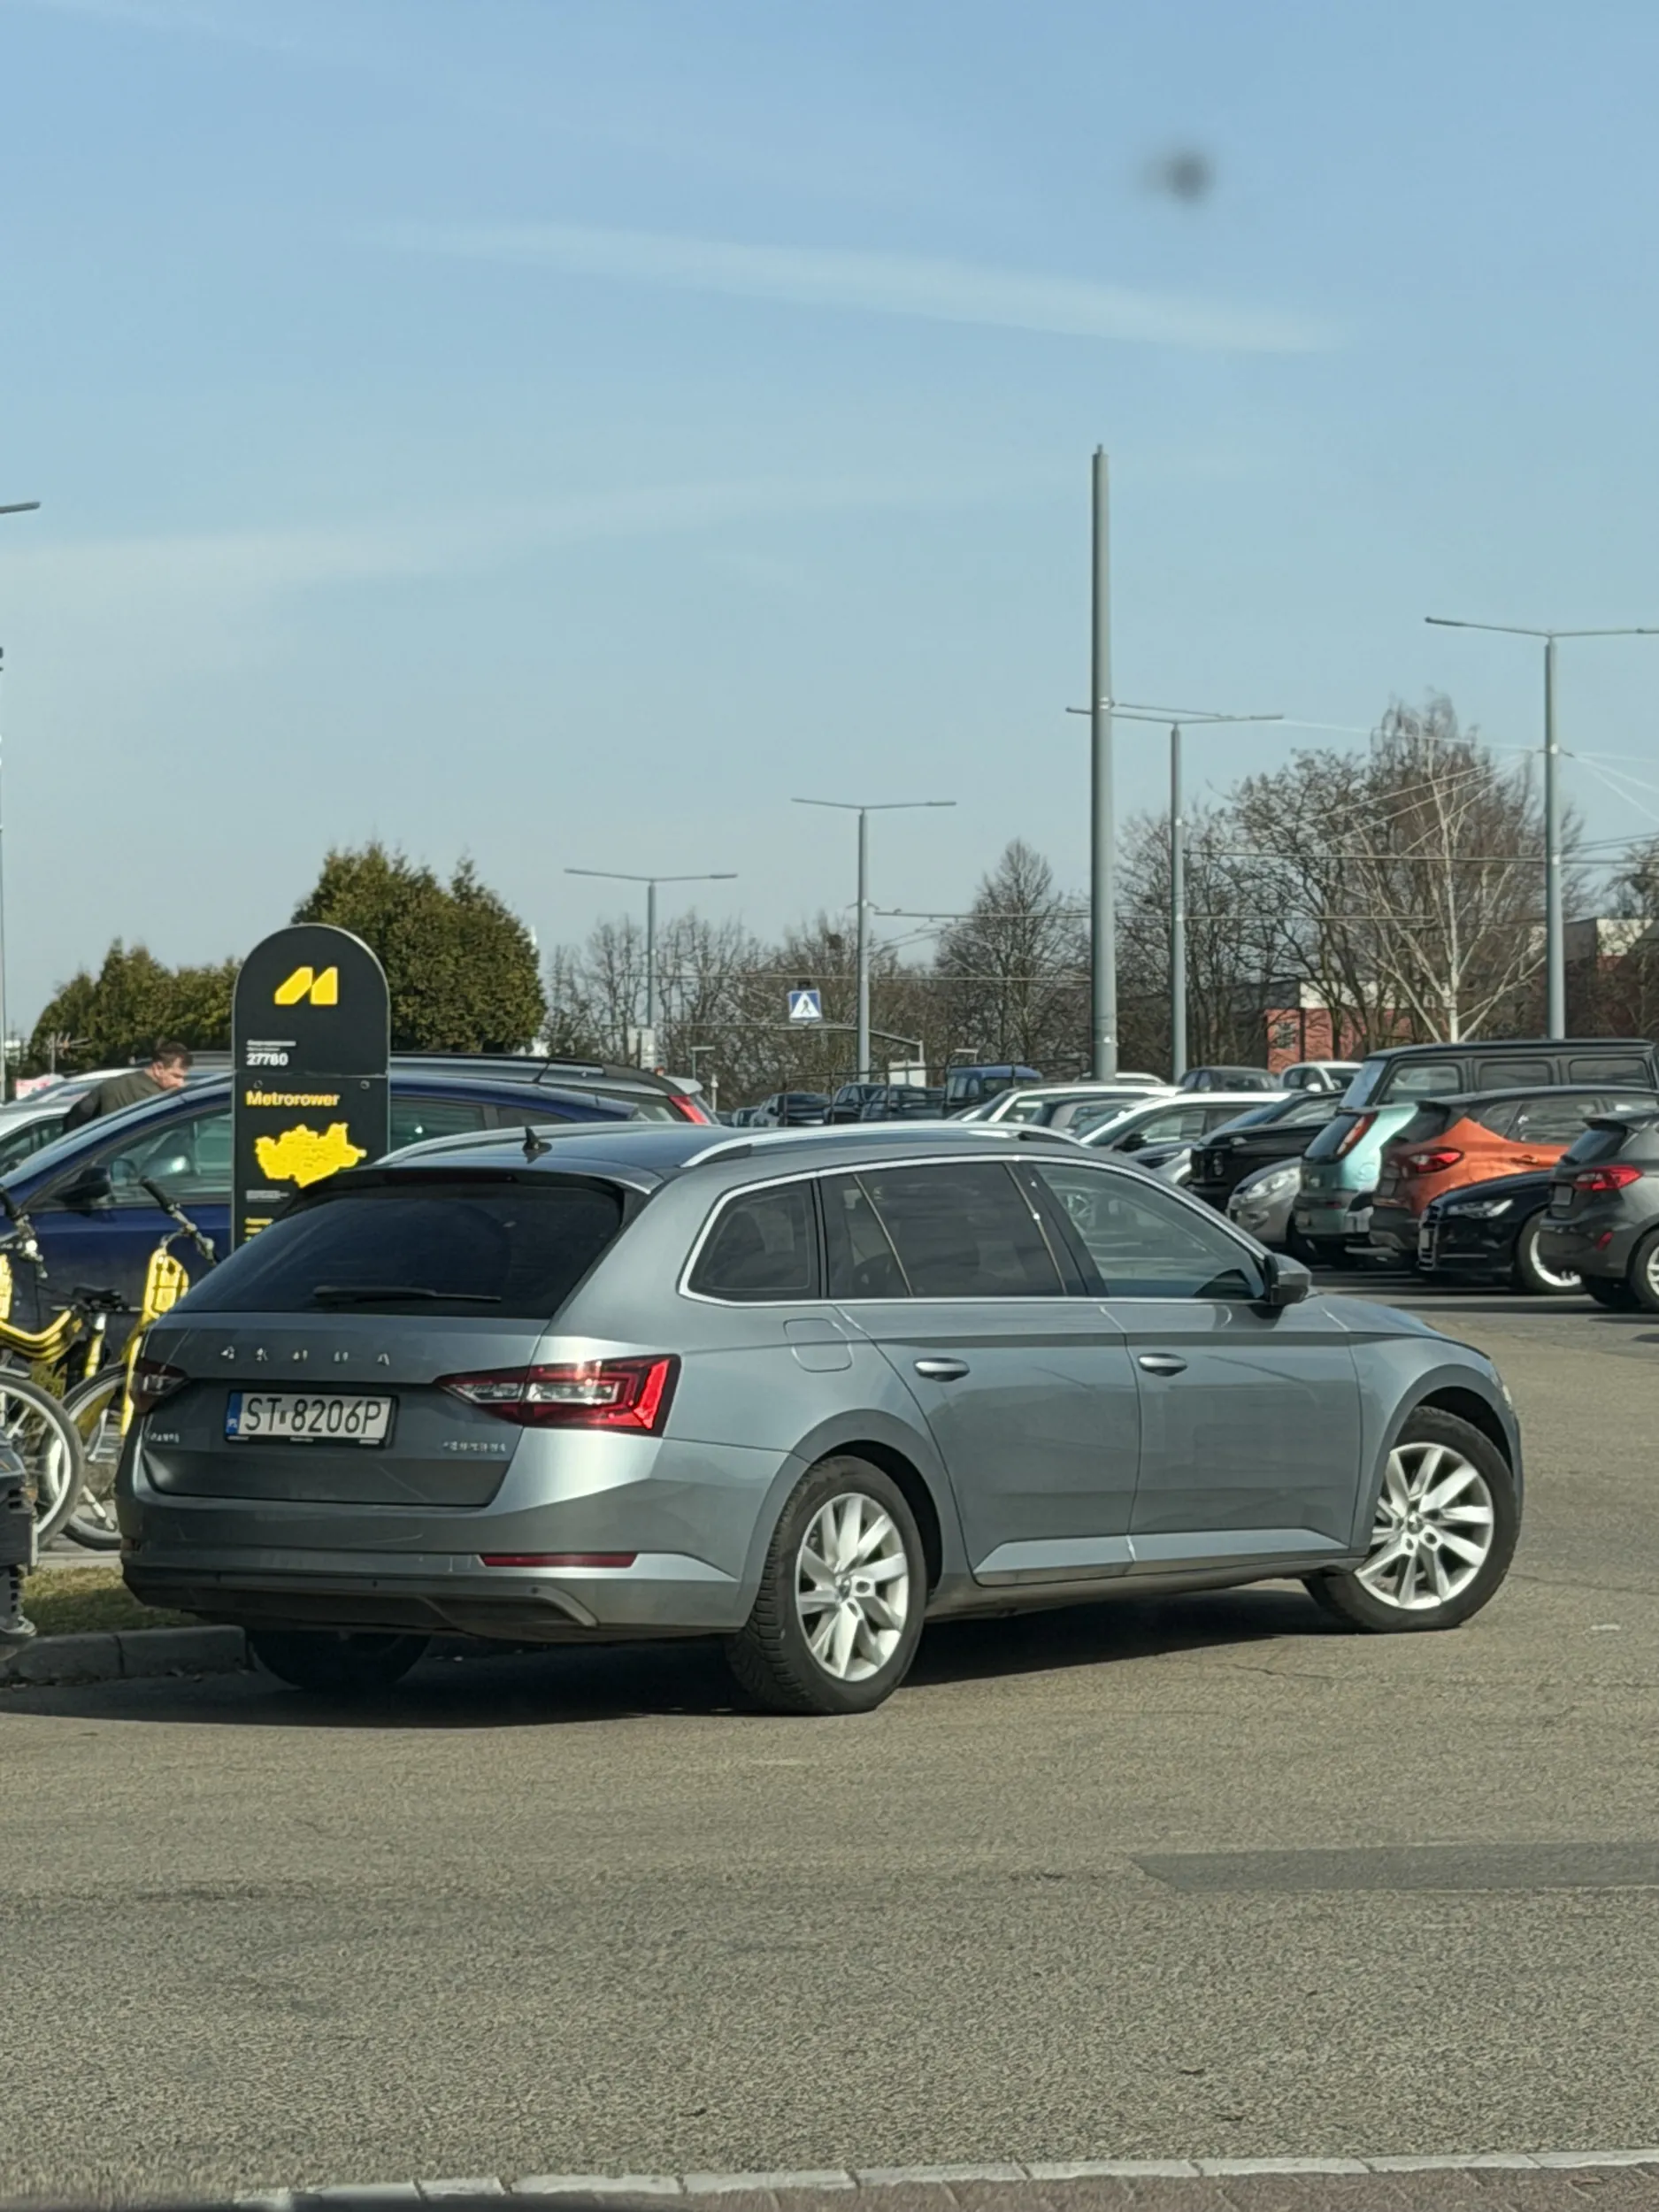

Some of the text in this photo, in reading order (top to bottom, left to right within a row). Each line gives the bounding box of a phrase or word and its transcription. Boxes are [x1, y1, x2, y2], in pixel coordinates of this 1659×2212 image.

[245, 1090, 341, 1106] Metrorower
[244, 1397, 382, 1434] ST 8206P
